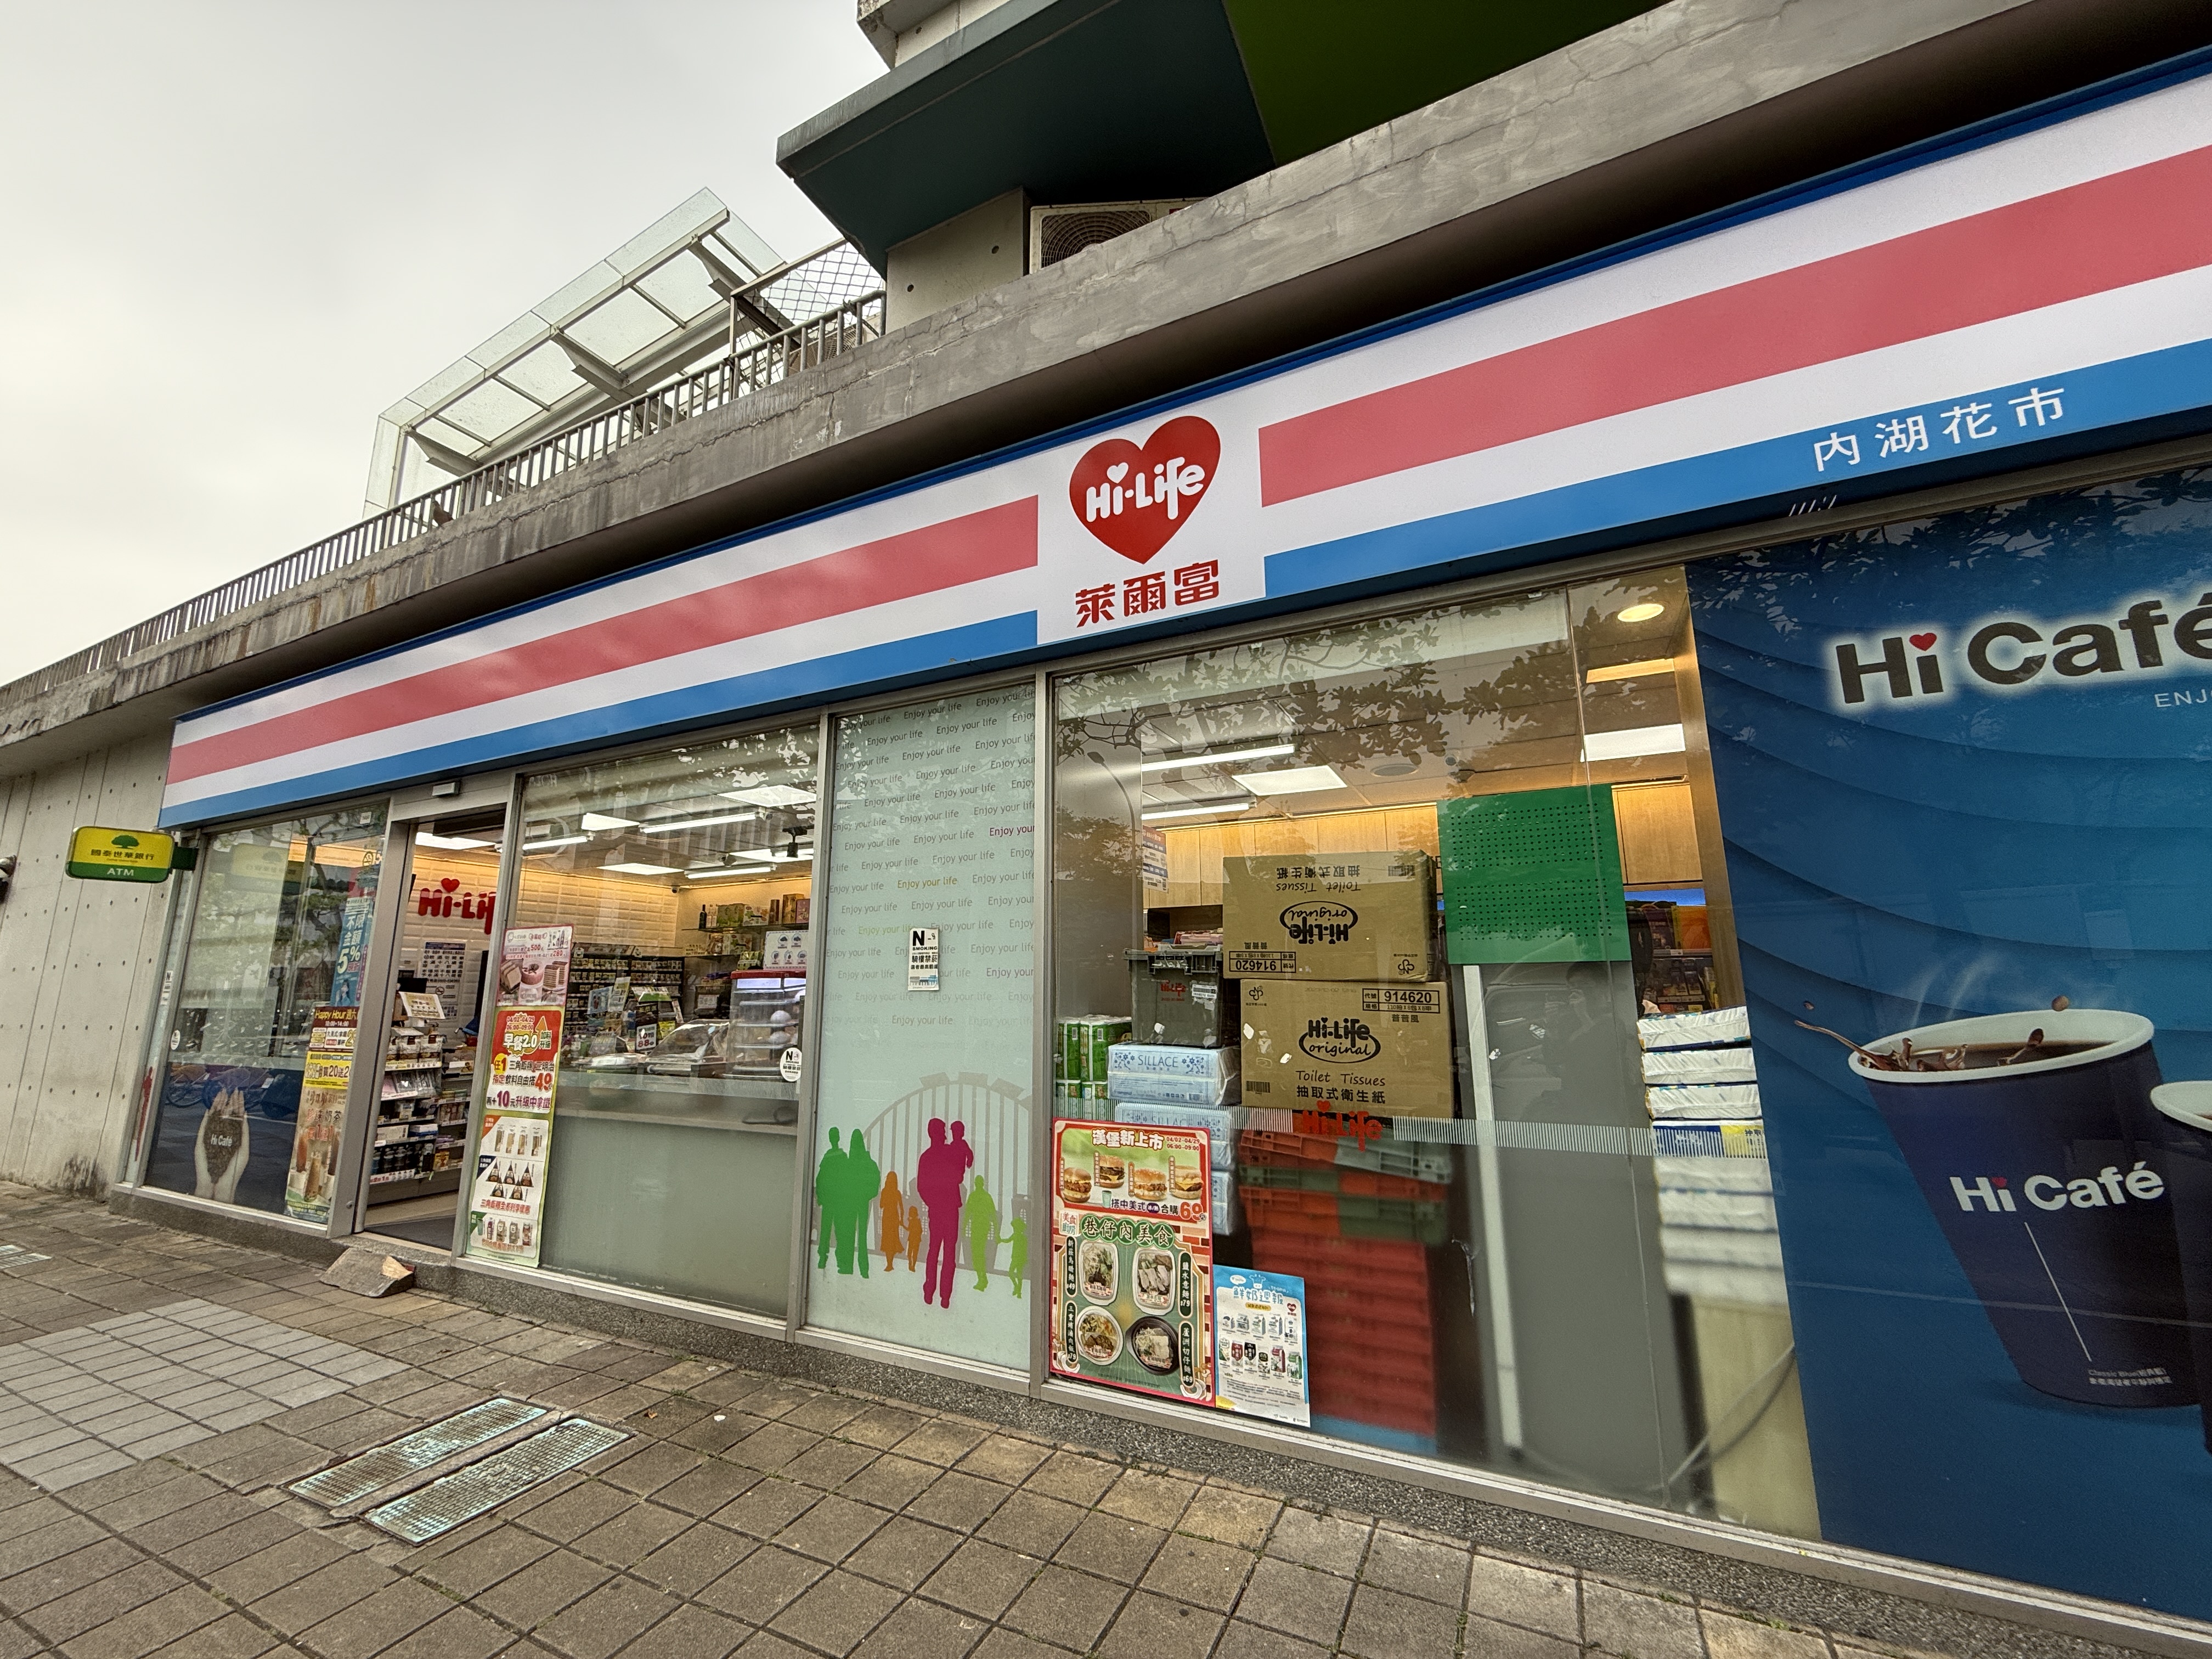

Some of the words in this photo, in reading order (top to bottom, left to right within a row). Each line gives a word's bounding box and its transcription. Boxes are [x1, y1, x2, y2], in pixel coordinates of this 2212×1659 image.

[1086, 456, 1205, 522] Hi-Life
[1075, 559, 1219, 628] 萊爾富
[1836, 632, 1943, 704] Hi
[976, 697, 1000, 707] Enjoy
[1002, 693, 1022, 704] your
[2154, 688, 2212, 708] ENJ
[904, 709, 926, 720] Enjoy
[928, 706, 946, 717] your
[948, 703, 962, 712] life
[936, 725, 959, 735] Enjoy
[961, 721, 980, 732] your
[983, 717, 997, 726] life
[867, 737, 888, 746] Enjoy
[890, 733, 907, 744] your
[910, 730, 923, 739] life
[975, 740, 999, 750] Enjoy
[1002, 736, 1022, 747] your
[902, 749, 925, 760] Enjoy
[927, 747, 945, 759] your
[947, 744, 961, 754] life
[857, 759, 874, 769] your
[876, 756, 889, 764] life
[991, 759, 1015, 770] Enjoy
[916, 770, 938, 780] Enjoy
[940, 767, 959, 778] your
[962, 764, 977, 773] life
[870, 776, 888, 788] your
[889, 774, 902, 783] life
[1011, 779, 1035, 789] Enjoy
[935, 789, 958, 799] Enjoy
[960, 786, 979, 797] your
[981, 783, 996, 792] life
[865, 798, 885, 808] Enjoy
[888, 795, 905, 806] your
[907, 793, 921, 802] life
[974, 806, 998, 816] Enjoy
[1001, 803, 1020, 815] your
[900, 814, 922, 825] Enjoy
[924, 812, 943, 823] your
[945, 809, 960, 819] life
[854, 820, 871, 831] your
[873, 818, 887, 827] life
[913, 835, 937, 845] Enjoy
[939, 832, 957, 843] your
[960, 830, 975, 839] life
[989, 827, 1014, 838] Enjoy
[867, 839, 885, 850] your
[887, 837, 901, 847] life
[91, 849, 155, 861] 國泰世華銀行
[932, 855, 956, 865] Enjoy
[958, 853, 978, 864] your
[980, 851, 995, 860] life
[1011, 848, 1035, 859] Enjoy
[861, 861, 883, 871] Enjoy
[885, 859, 903, 870] your
[905, 856, 919, 866] life
[107, 867, 134, 877] ATM
[972, 874, 997, 885] Enjoy
[999, 872, 1020, 884] your
[1277, 865, 1361, 879] 抽取式衛生紙
[830, 884, 849, 895] Enjoy
[851, 883, 869, 894] your
[871, 881, 884, 890] life
[898, 879, 921, 890] Enjoy
[922, 878, 941, 889] your
[943, 876, 958, 885] life
[1276, 882, 1317, 894] Tissues
[1326, 881, 1361, 893] Toilet
[418, 878, 496, 935] Hi-Lif
[842, 905, 862, 915] Enjoy
[864, 904, 882, 915] your
[884, 901, 898, 911] life
[911, 900, 934, 911] Enjoy
[936, 900, 956, 910] your
[958, 898, 973, 907] life
[988, 895, 1013, 907] Enjoy
[1288, 906, 1348, 921] original
[957, 922, 976, 933] your
[978, 919, 994, 929] life
[1009, 918, 1034, 930] Enjoy
[1289, 916, 1349, 945] Hi-Life
[912, 930, 925, 946] N
[941, 944, 956, 954] life
[970, 944, 996, 955] Enjoy
[998, 943, 1019, 955] your
[337, 945, 361, 974] 5%
[1235, 960, 1277, 971] 914620
[986, 967, 1012, 979] Enjoy
[1384, 991, 1432, 1003] 914620
[315, 1009, 332, 1020] Happy
[331, 1009, 346, 1019] Hour
[891, 1015, 915, 1026] Enjoy
[917, 1015, 936, 1026] your
[938, 1015, 953, 1025] life
[1308, 1017, 1370, 1048] Hi-Life
[503, 1033, 538, 1052] 早餐2.0
[1309, 1041, 1372, 1057] original
[786, 1051, 793, 1061] N
[1137, 1054, 1180, 1069] SILLACE
[323, 1064, 351, 1079] 買20送2
[1295, 1070, 1331, 1083] Toilet
[1340, 1073, 1386, 1087] Tissues
[1296, 1085, 1386, 1104] 抽取式衛生紙
[1302, 1100, 1383, 1152] Hi-Life
[1092, 1128, 1165, 1150] 漢堡新上市
[1950, 1176, 2017, 1213] Hi
[2024, 1161, 2165, 1211] Café
[1233, 1287, 1284, 1306] 鮮奶週報
